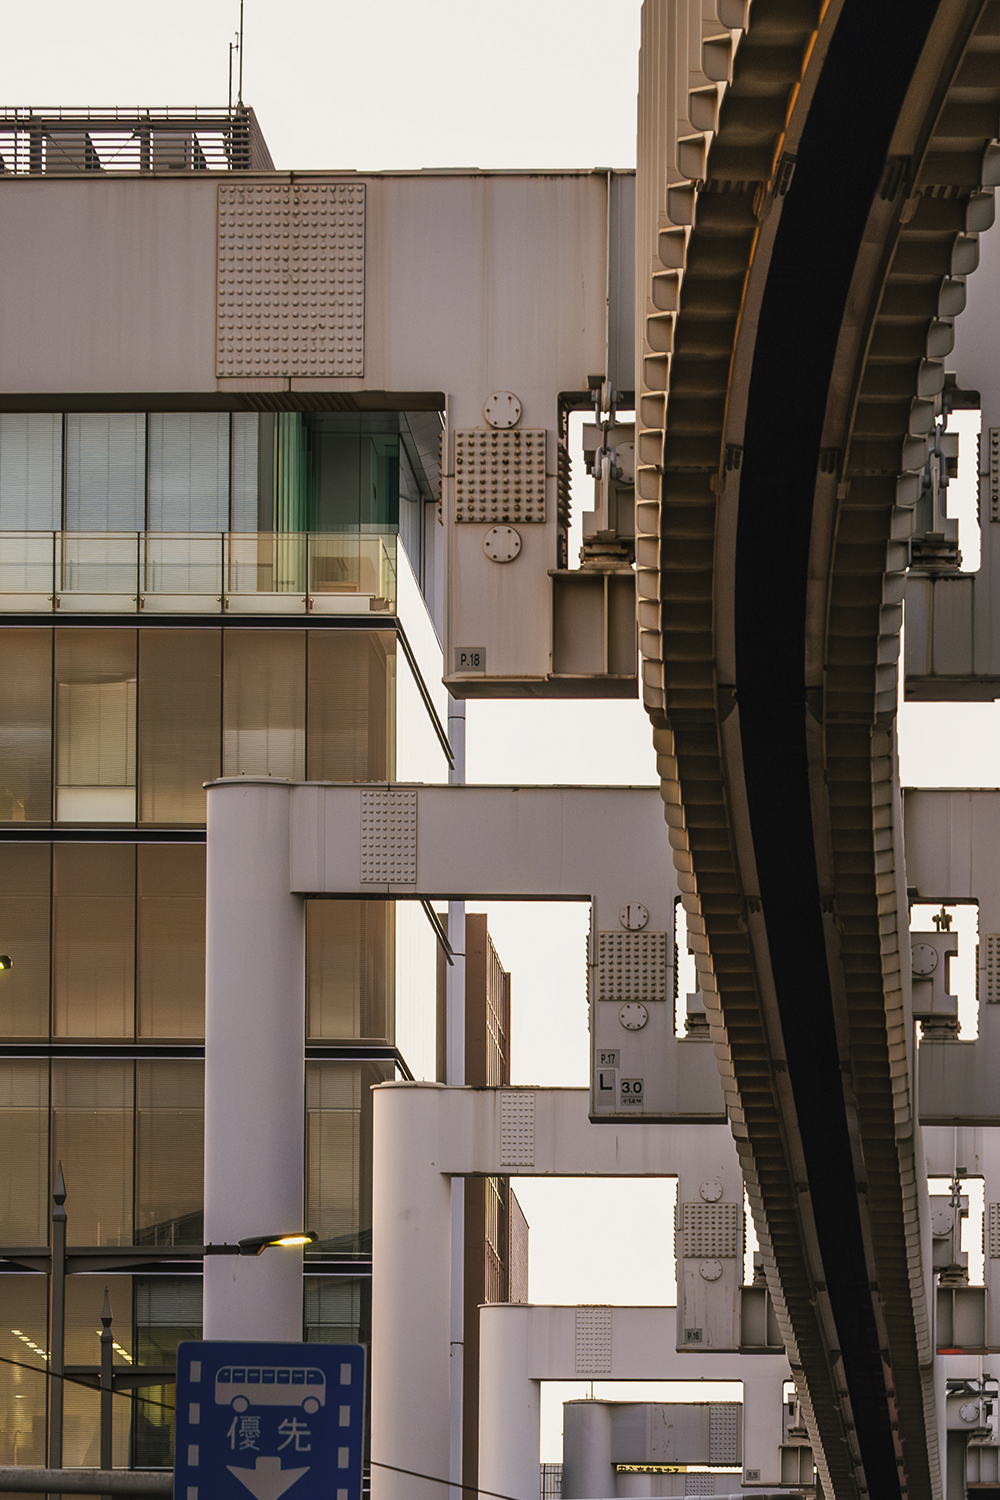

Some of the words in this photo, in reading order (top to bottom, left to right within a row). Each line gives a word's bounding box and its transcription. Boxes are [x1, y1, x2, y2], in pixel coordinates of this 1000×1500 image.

[460, 653, 480, 666] P.18
[600, 1053, 616, 1064] P.17
[600, 1073, 613, 1090] L
[621, 1081, 642, 1094] 3.0
[226, 1416, 312, 1451] 優先
